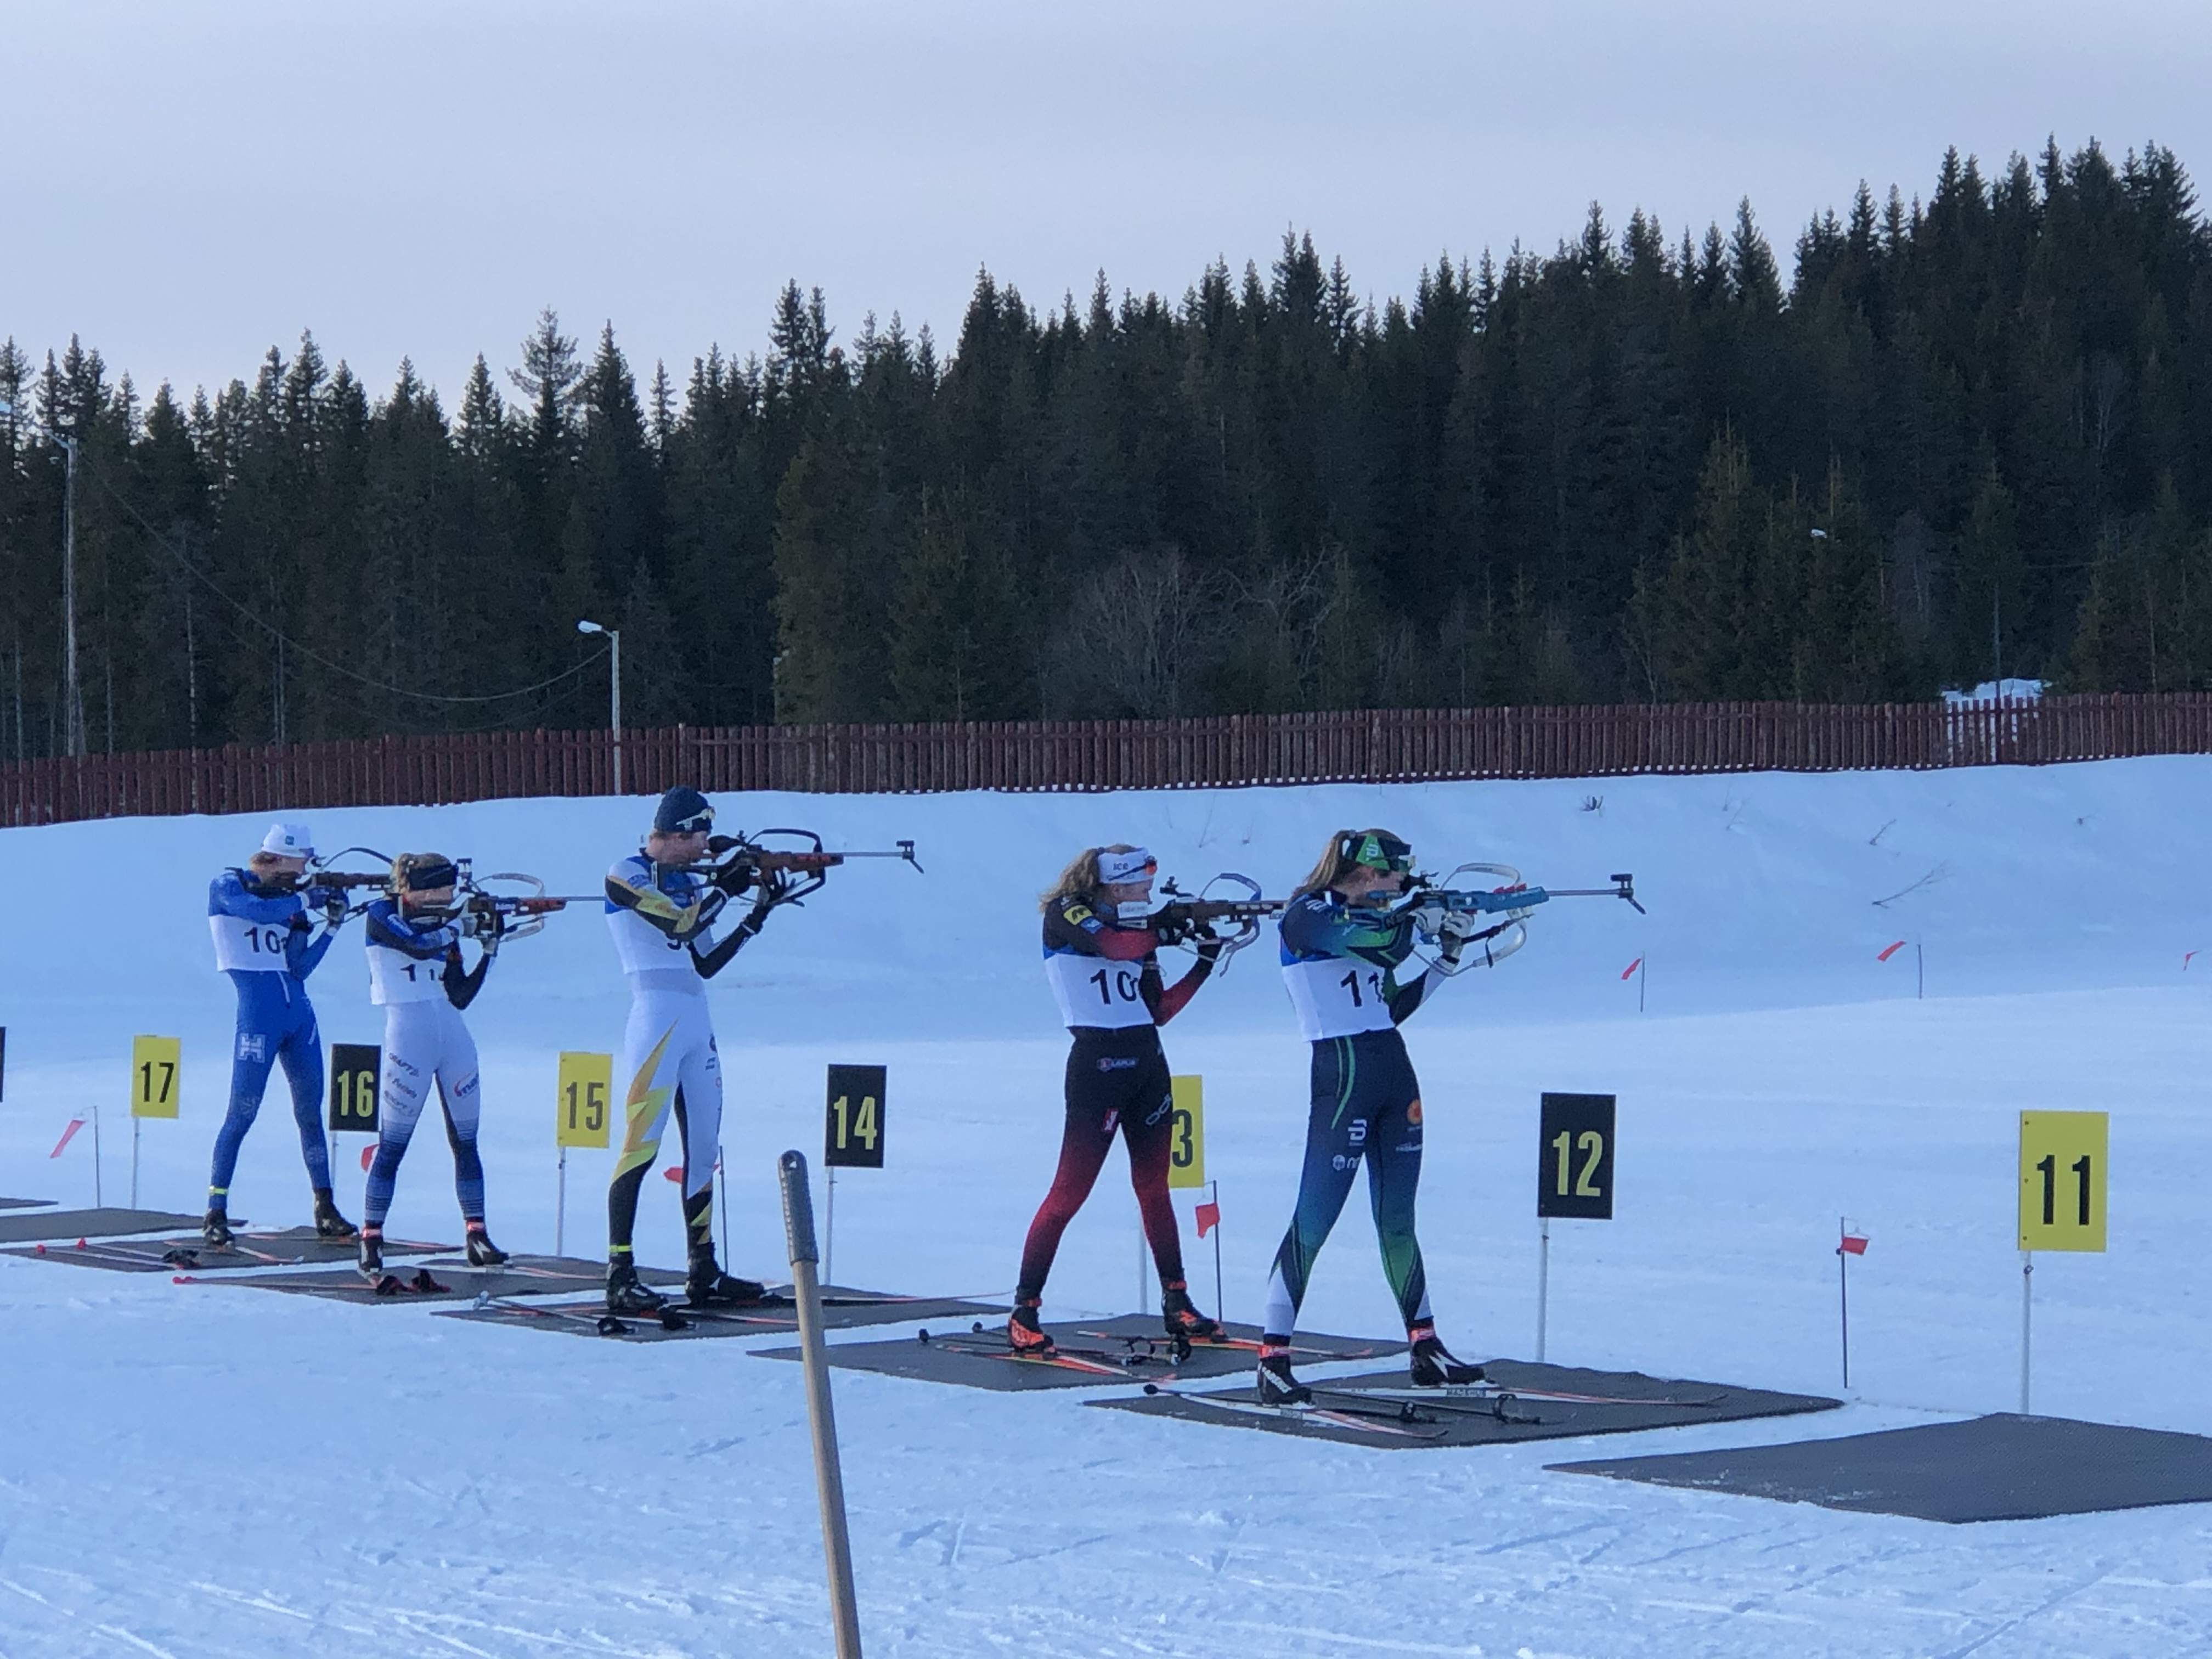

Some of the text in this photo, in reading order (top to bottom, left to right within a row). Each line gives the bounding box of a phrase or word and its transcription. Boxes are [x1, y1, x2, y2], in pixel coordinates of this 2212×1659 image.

[244, 927, 286, 954] 10
[1090, 969, 1139, 1005] 10
[140, 1061, 174, 1103] 17
[337, 1070, 374, 1118] 16
[566, 1081, 605, 1131] 15
[833, 1096, 877, 1150] 14
[1172, 1109, 1193, 1168] 3
[1553, 1131, 1602, 1197] 12
[2036, 1154, 2090, 1226] 11
